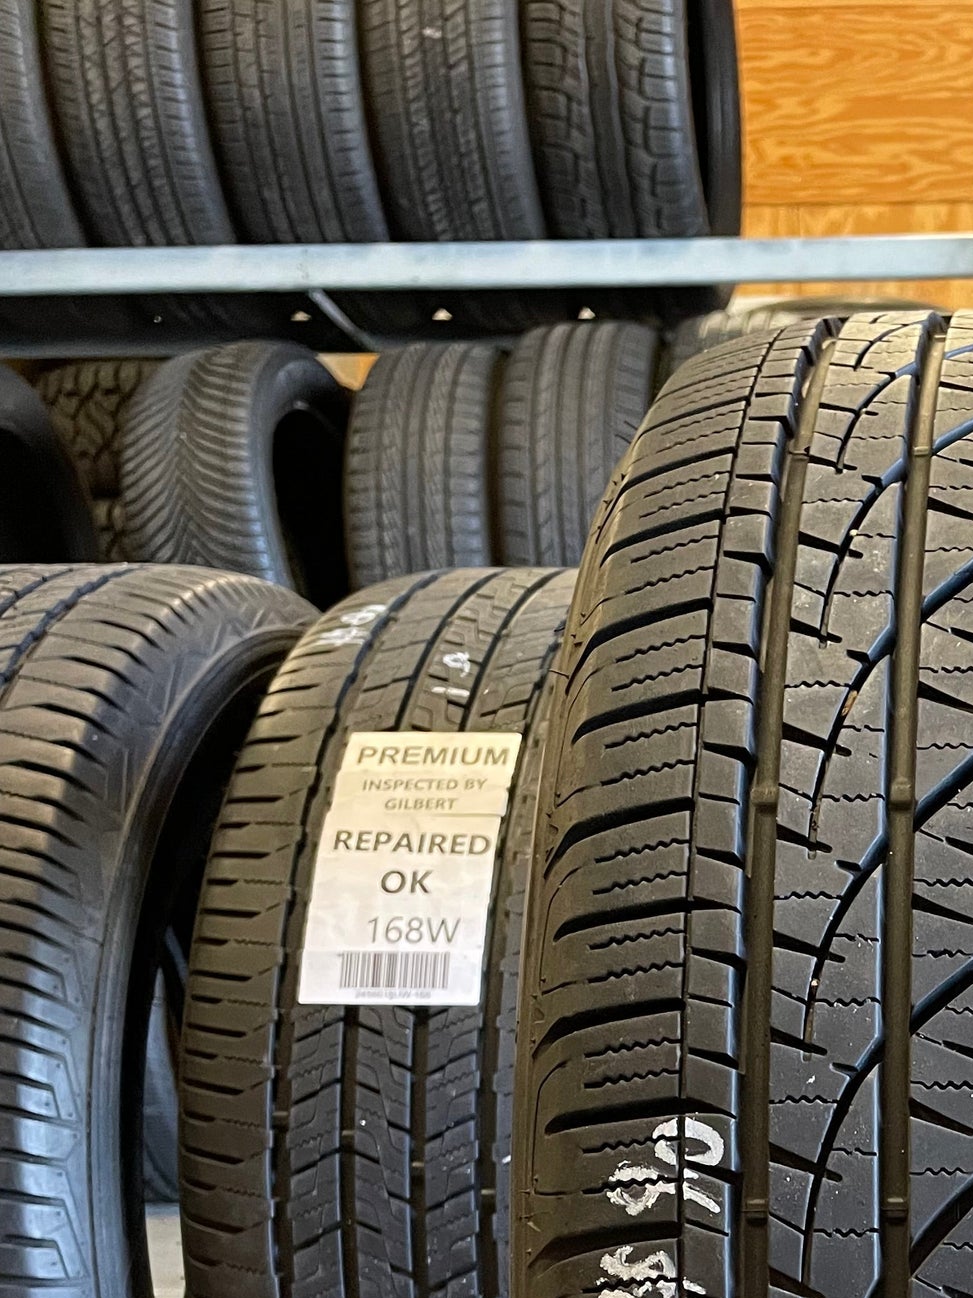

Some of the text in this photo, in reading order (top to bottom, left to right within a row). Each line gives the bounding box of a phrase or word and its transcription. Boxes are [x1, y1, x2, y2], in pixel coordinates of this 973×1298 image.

[357, 745, 510, 767] PREMIUM
[362, 777, 488, 792] INSPECTED BY
[384, 797, 459, 811] GILBERT
[333, 830, 491, 856] REPAIRED
[380, 869, 433, 895] OK
[367, 917, 461, 944] 168W
